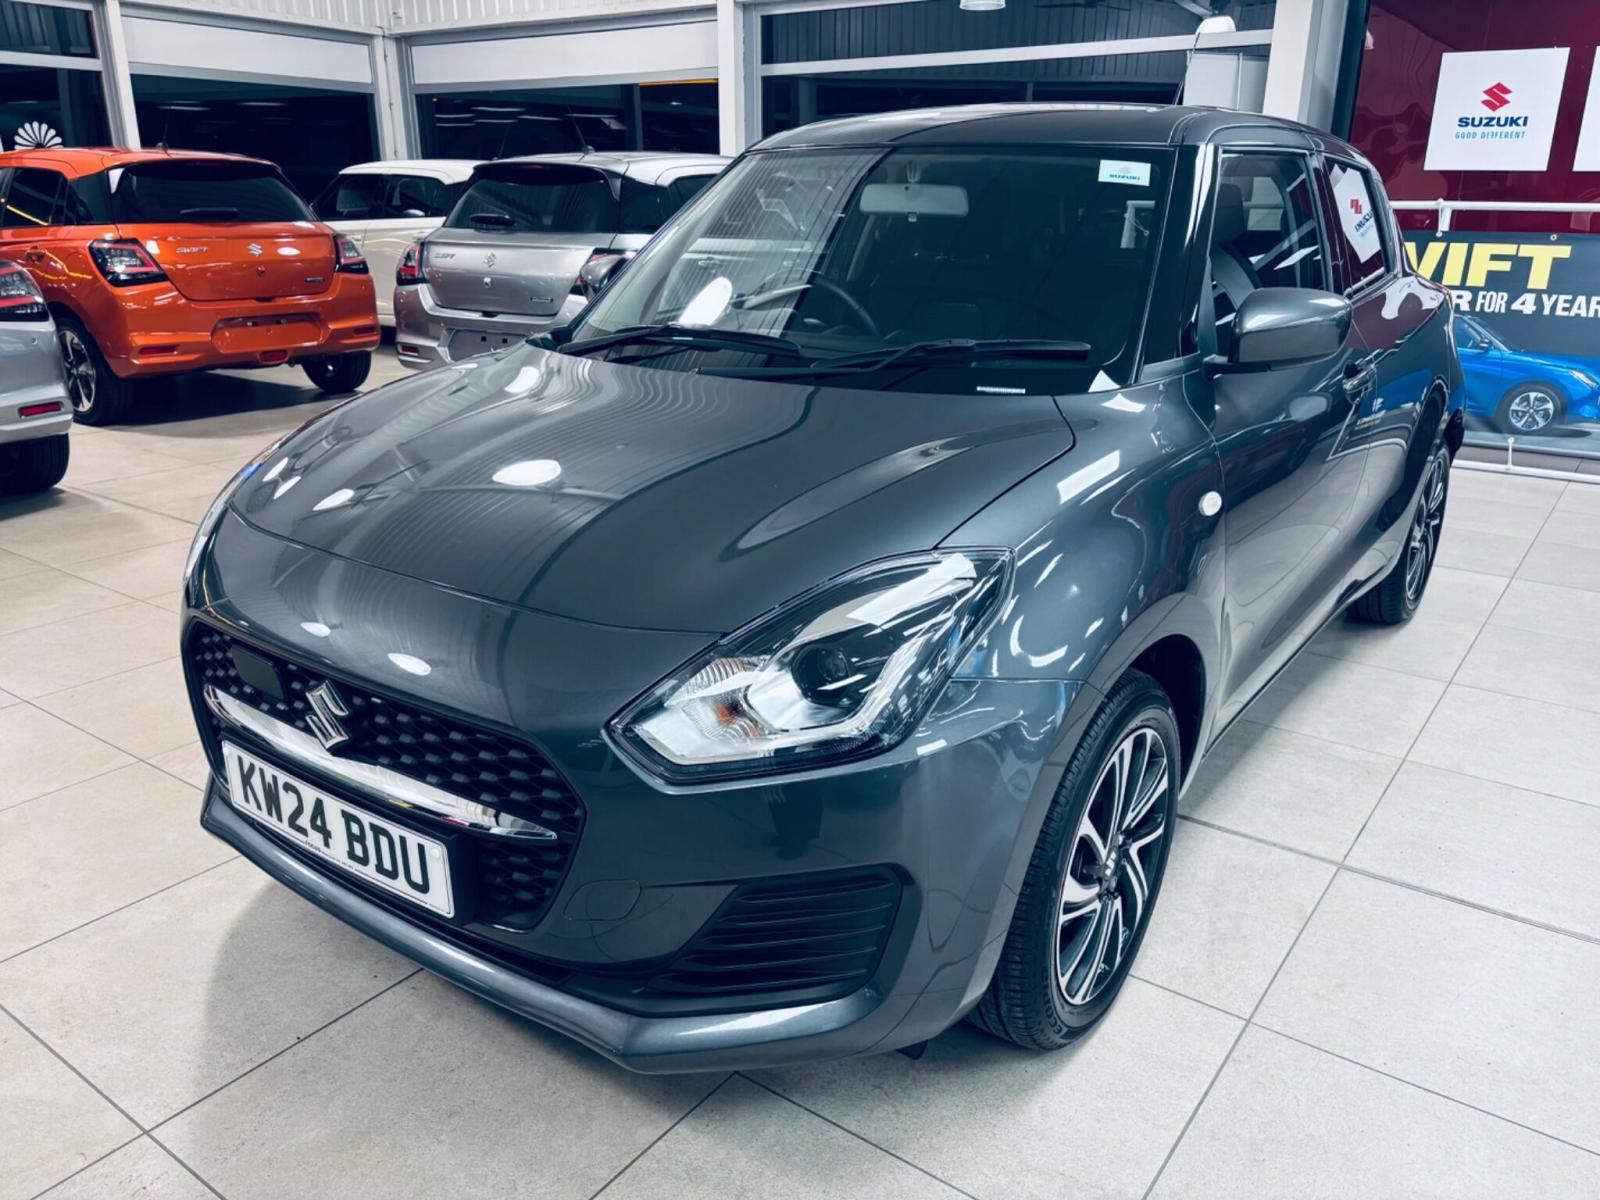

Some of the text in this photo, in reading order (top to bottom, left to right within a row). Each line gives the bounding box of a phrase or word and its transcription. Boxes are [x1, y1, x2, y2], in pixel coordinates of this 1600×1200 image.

[1457, 116, 1528, 127] SUZUKI
[1455, 131, 1525, 139] GOOD DIFFERENT
[1475, 291, 1508, 313] FOR
[1511, 293, 1536, 315] 4
[237, 756, 431, 895] KW24 BDU
